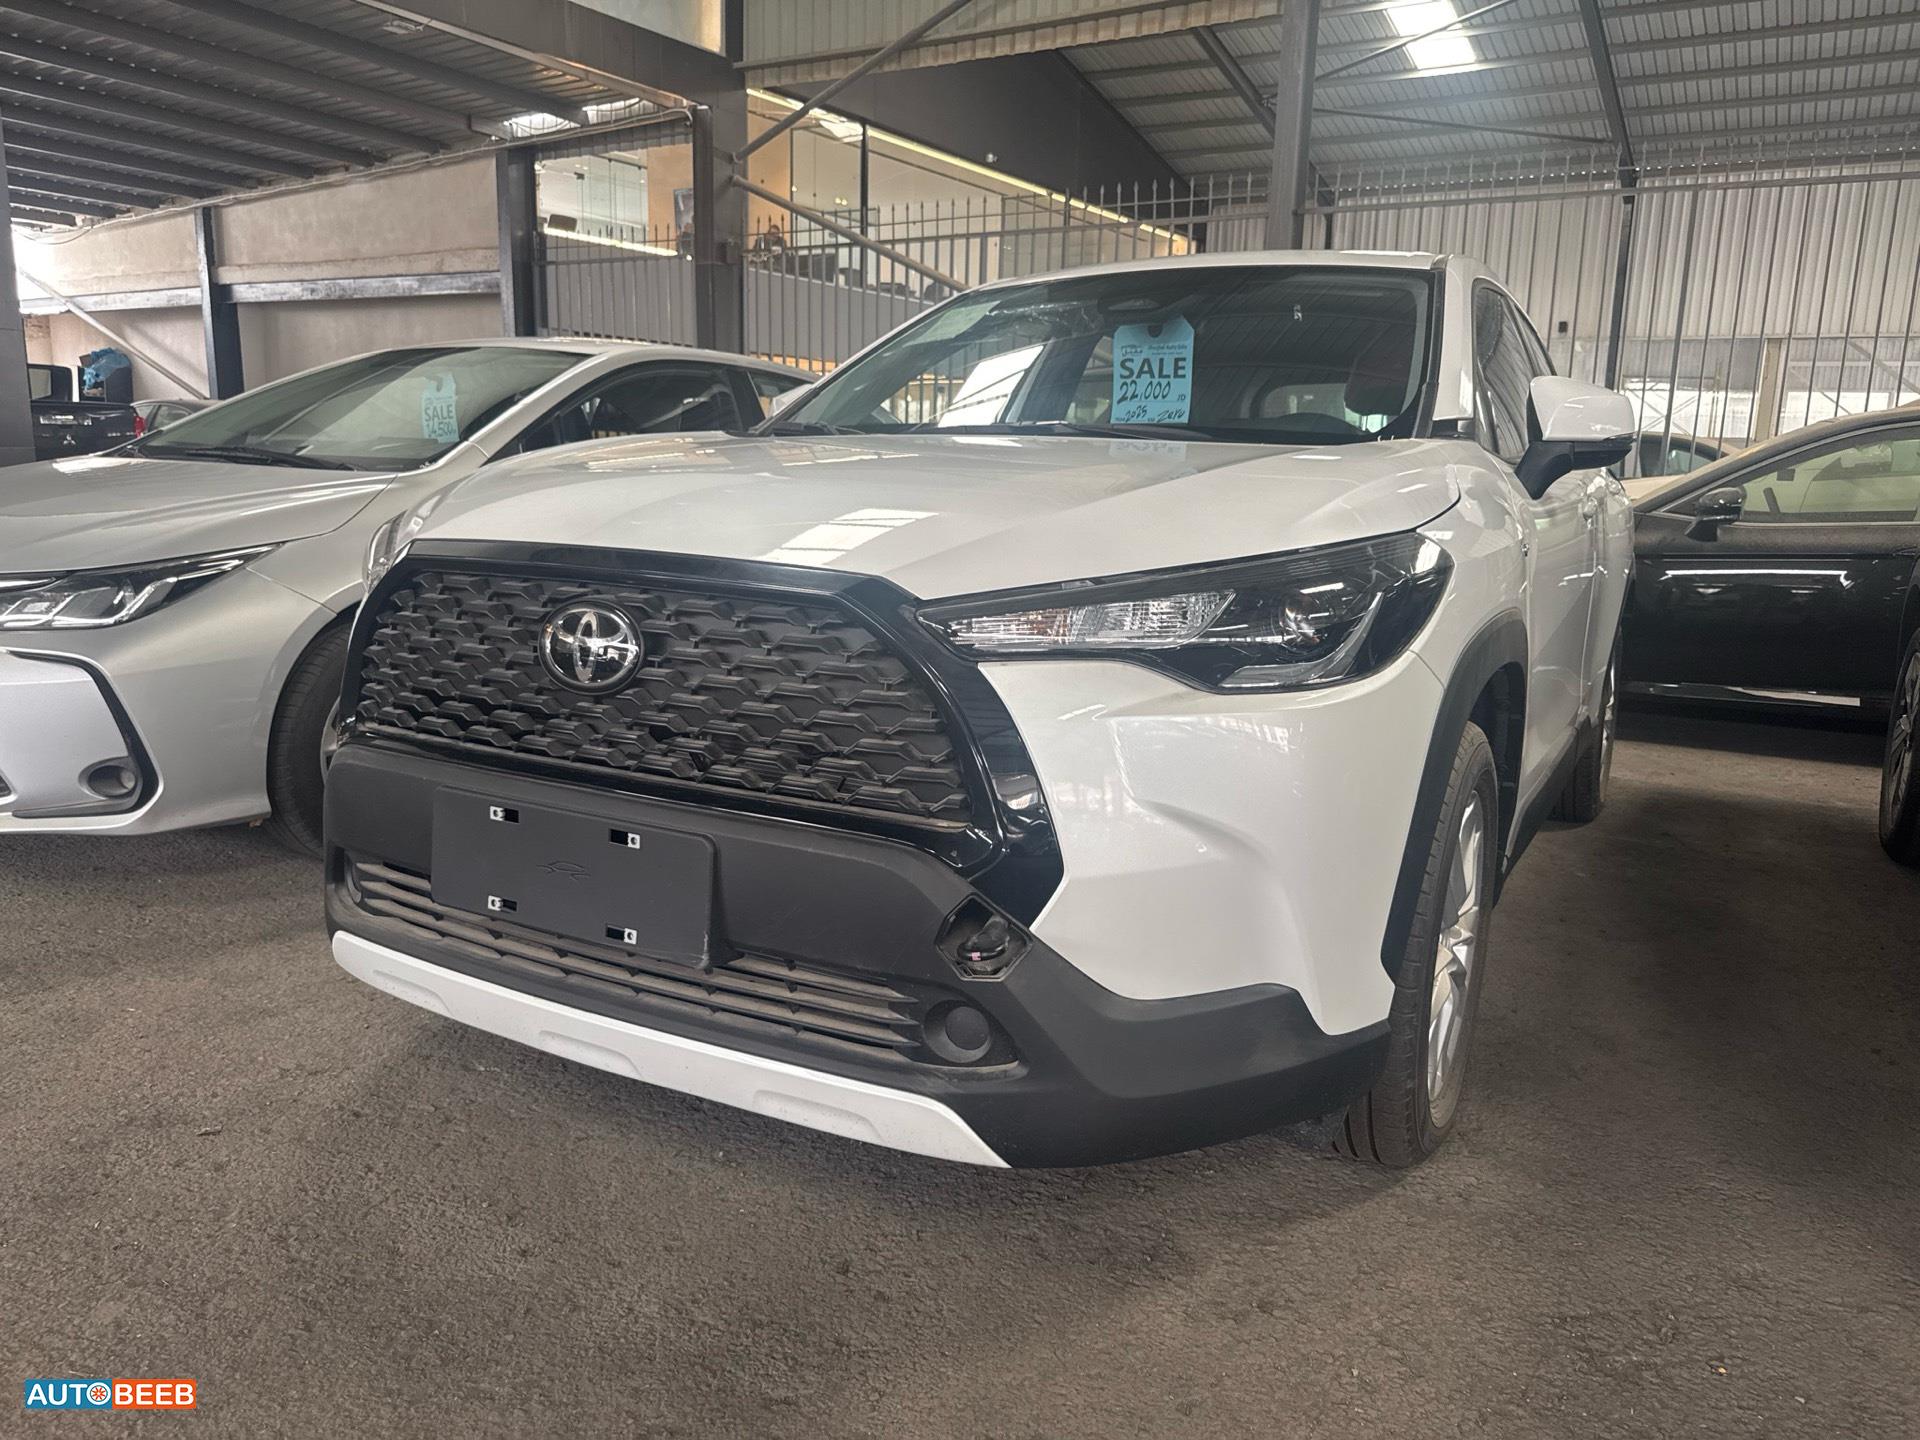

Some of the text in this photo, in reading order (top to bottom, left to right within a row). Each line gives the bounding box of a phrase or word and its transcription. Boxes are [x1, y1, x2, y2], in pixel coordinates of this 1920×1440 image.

[1120, 358, 1186, 379] SALE
[1117, 380, 1171, 405] 22,000
[424, 404, 454, 422] SALE
